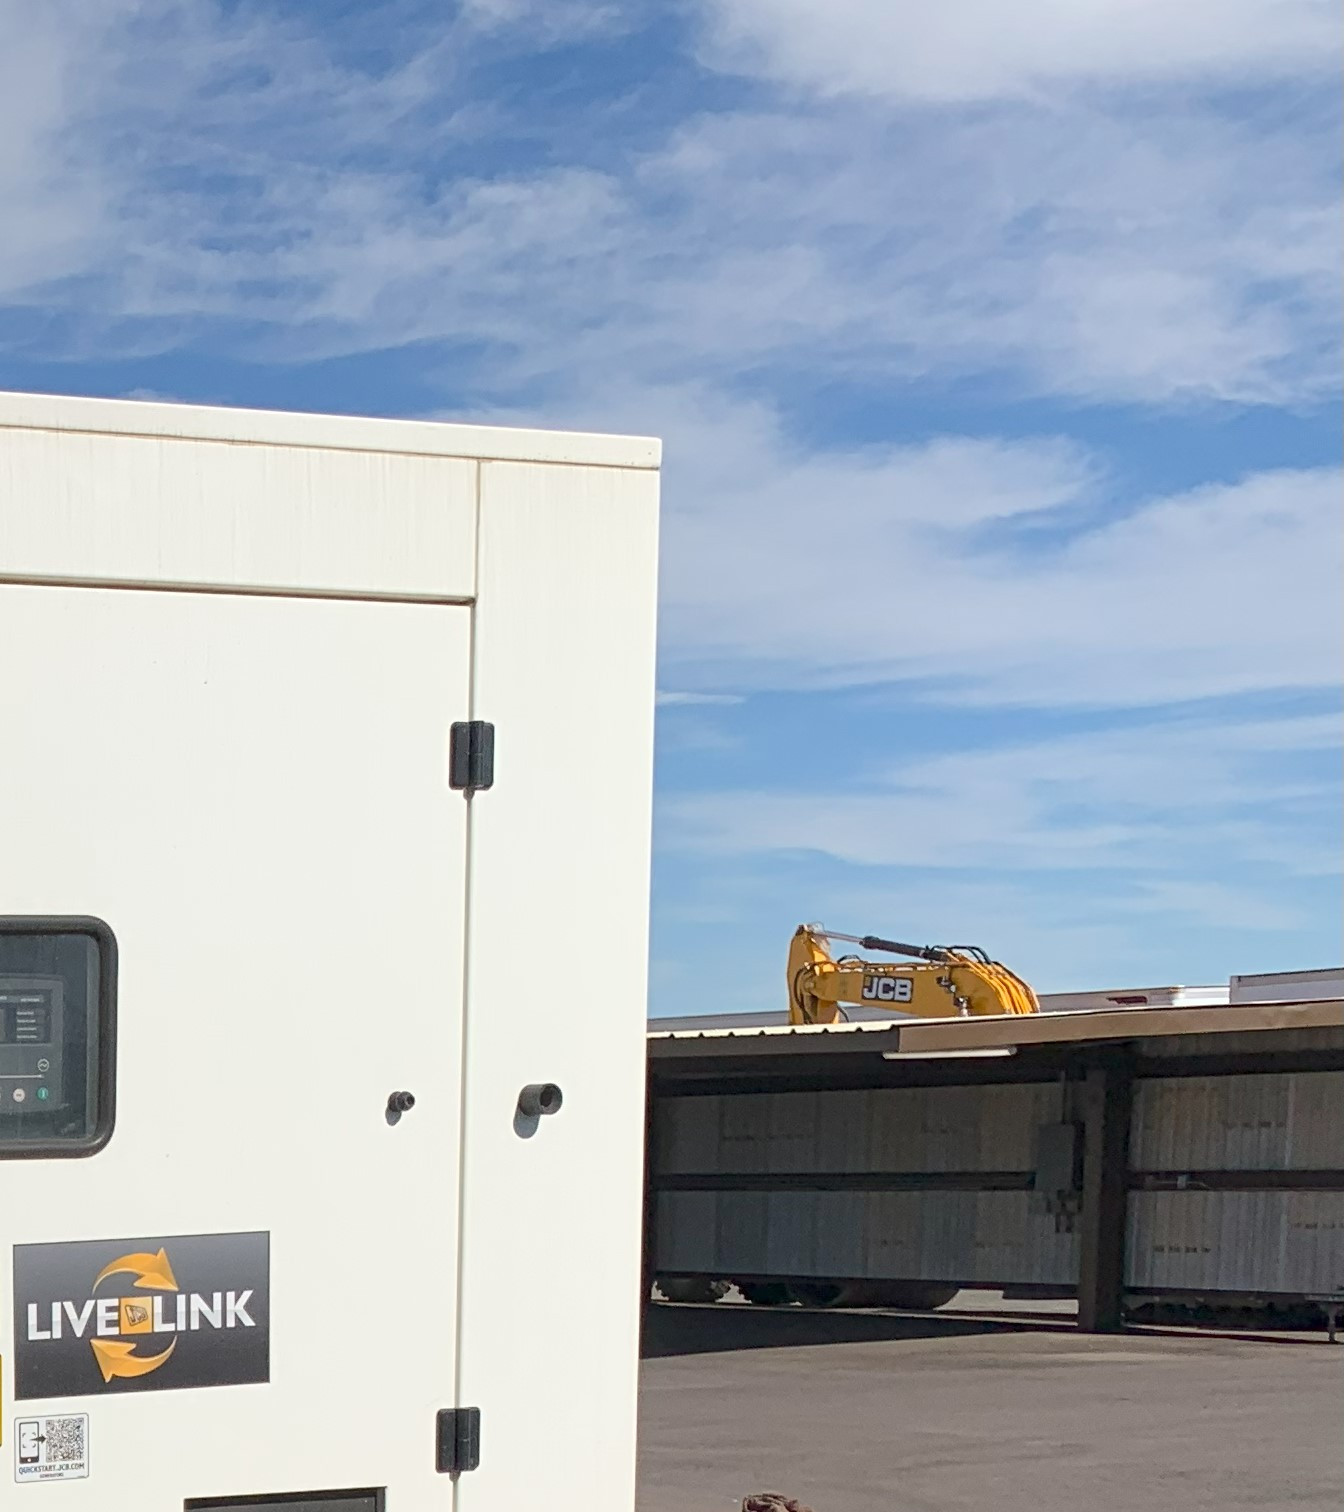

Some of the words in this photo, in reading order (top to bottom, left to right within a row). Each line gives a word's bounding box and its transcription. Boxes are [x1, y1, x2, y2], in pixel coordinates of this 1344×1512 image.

[863, 977, 912, 1001] JCB
[28, 1298, 120, 1341] LIVE
[153, 1290, 256, 1332] LINK
